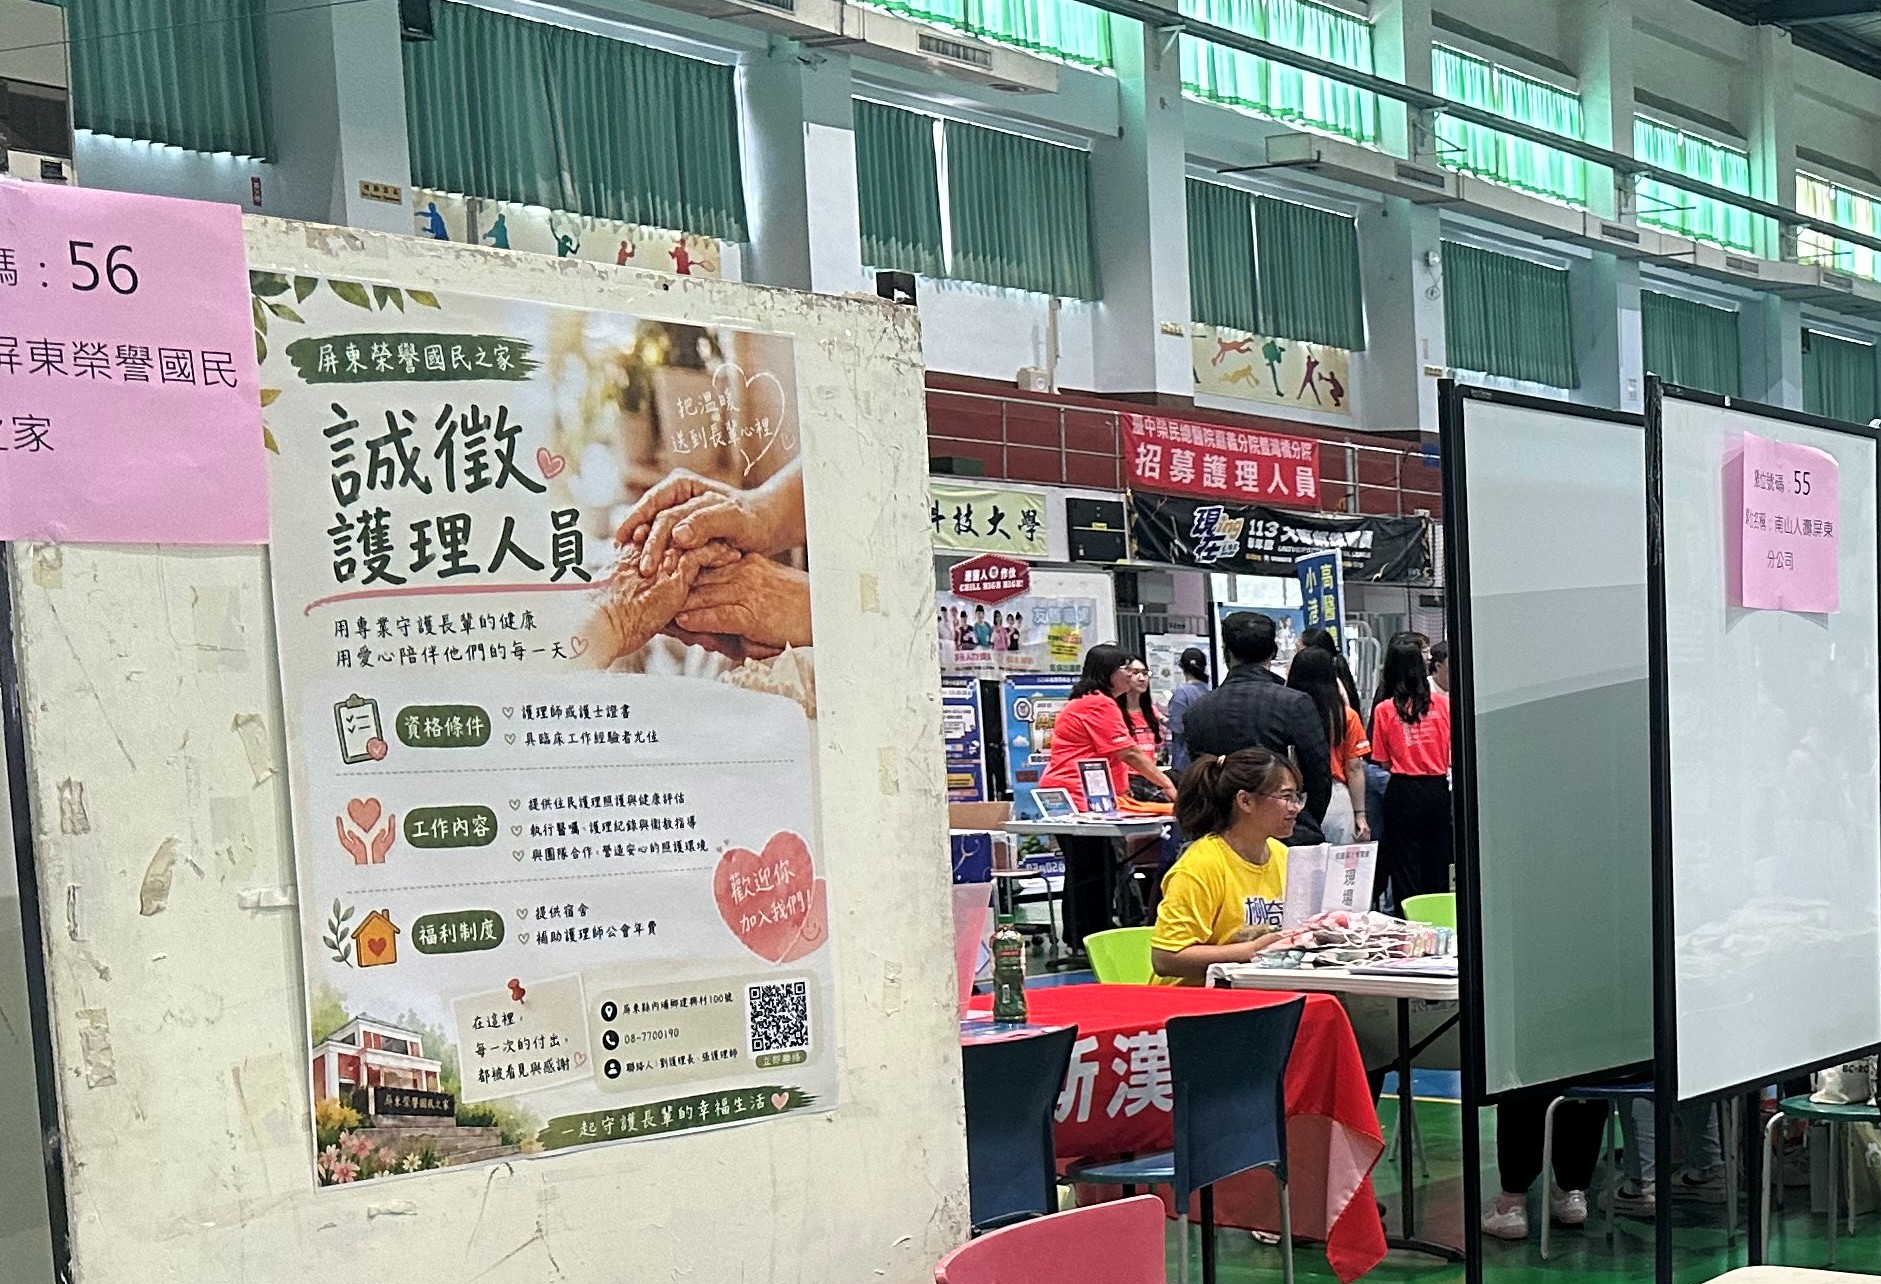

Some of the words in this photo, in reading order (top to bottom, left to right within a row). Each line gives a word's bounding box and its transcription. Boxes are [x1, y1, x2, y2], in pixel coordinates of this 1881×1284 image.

[316, 341, 517, 375] 屏東榮譽國民之家
[676, 387, 741, 419] 把溫暖
[0, 413, 55, 453] 家
[321, 402, 547, 507] 誠徵
[1135, 441, 1317, 499] 招募護理人員
[327, 508, 593, 585] 護理人員
[333, 609, 538, 640] 用專業守護長輩的健康
[335, 640, 567, 669] 用愛心陪伴他們的每一天
[521, 704, 631, 720] 護理師或護士證書
[403, 716, 484, 739] 資格條件
[524, 730, 659, 746] 具臨床工作經驗者尤佳
[411, 814, 492, 838] 工作內容
[729, 859, 796, 905] 歡迎你
[535, 902, 590, 921] 提供宿舍
[418, 917, 499, 945] 福利制度
[536, 920, 657, 945] 補助護理師公會年費
[477, 1057, 571, 1084] 都被看見與感謝
[560, 1092, 766, 1138] 一起守護長輩的幸福生活
